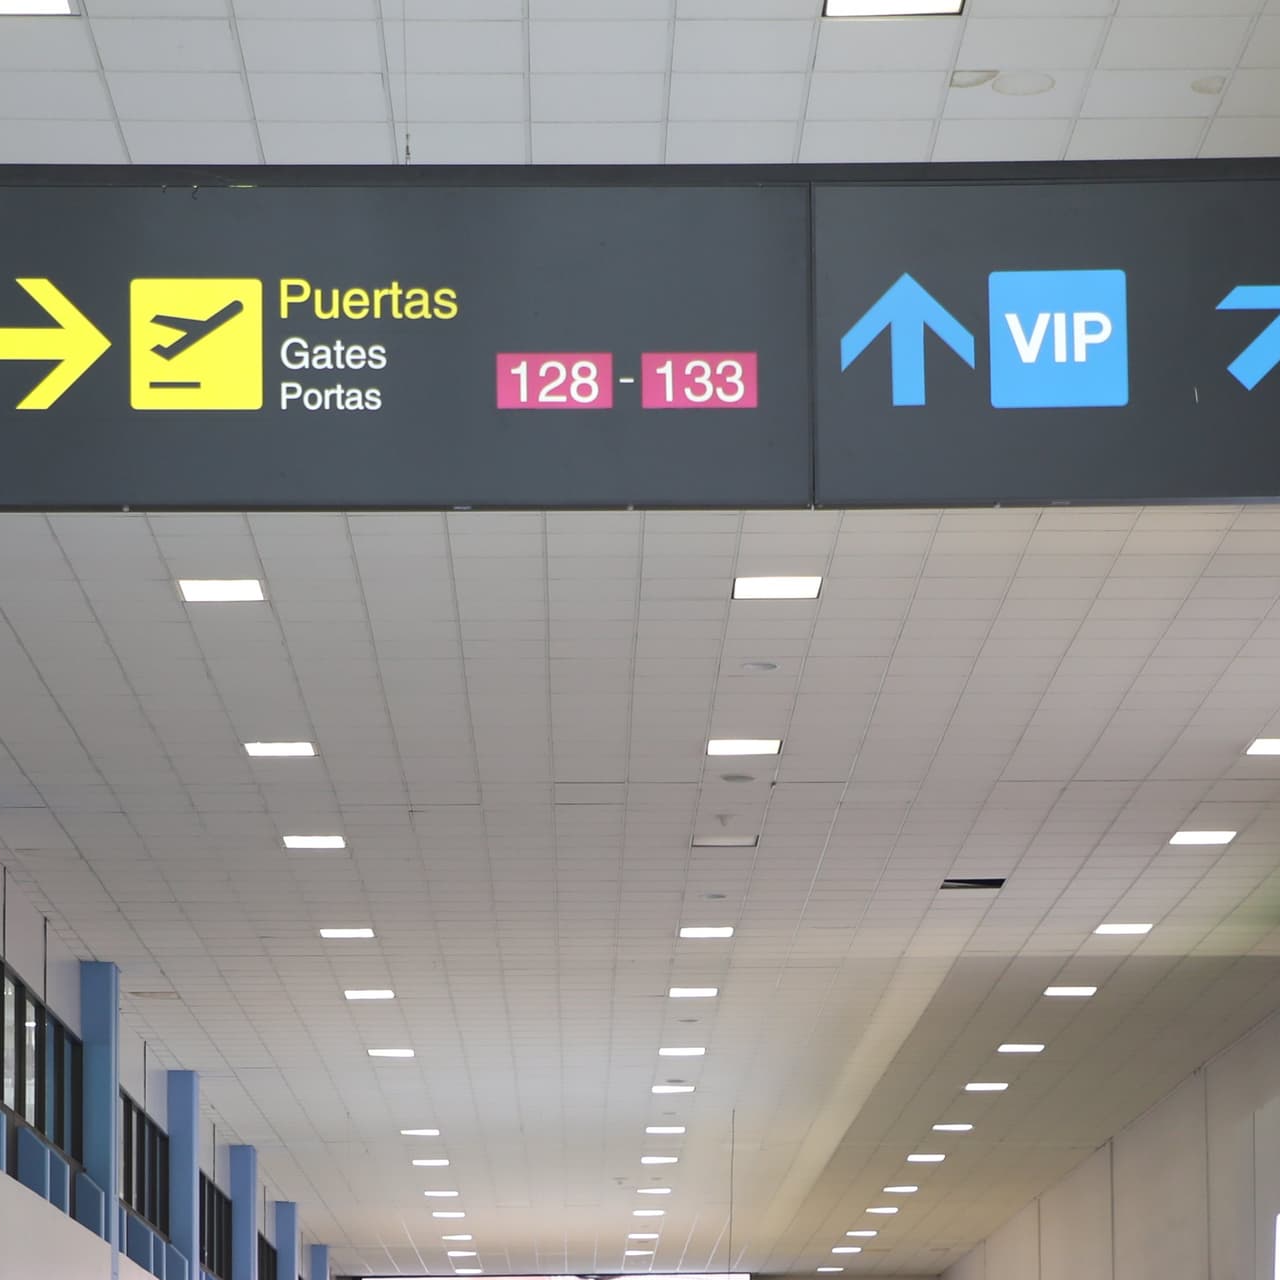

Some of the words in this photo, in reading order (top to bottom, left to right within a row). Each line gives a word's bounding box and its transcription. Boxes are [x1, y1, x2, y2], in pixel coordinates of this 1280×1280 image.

[279, 278, 459, 322] Puertas
[280, 337, 387, 371] Gates
[1005, 312, 1112, 364] VIP
[280, 382, 382, 412] Portas
[511, 361, 600, 403] 128
[655, 361, 746, 403] 133
